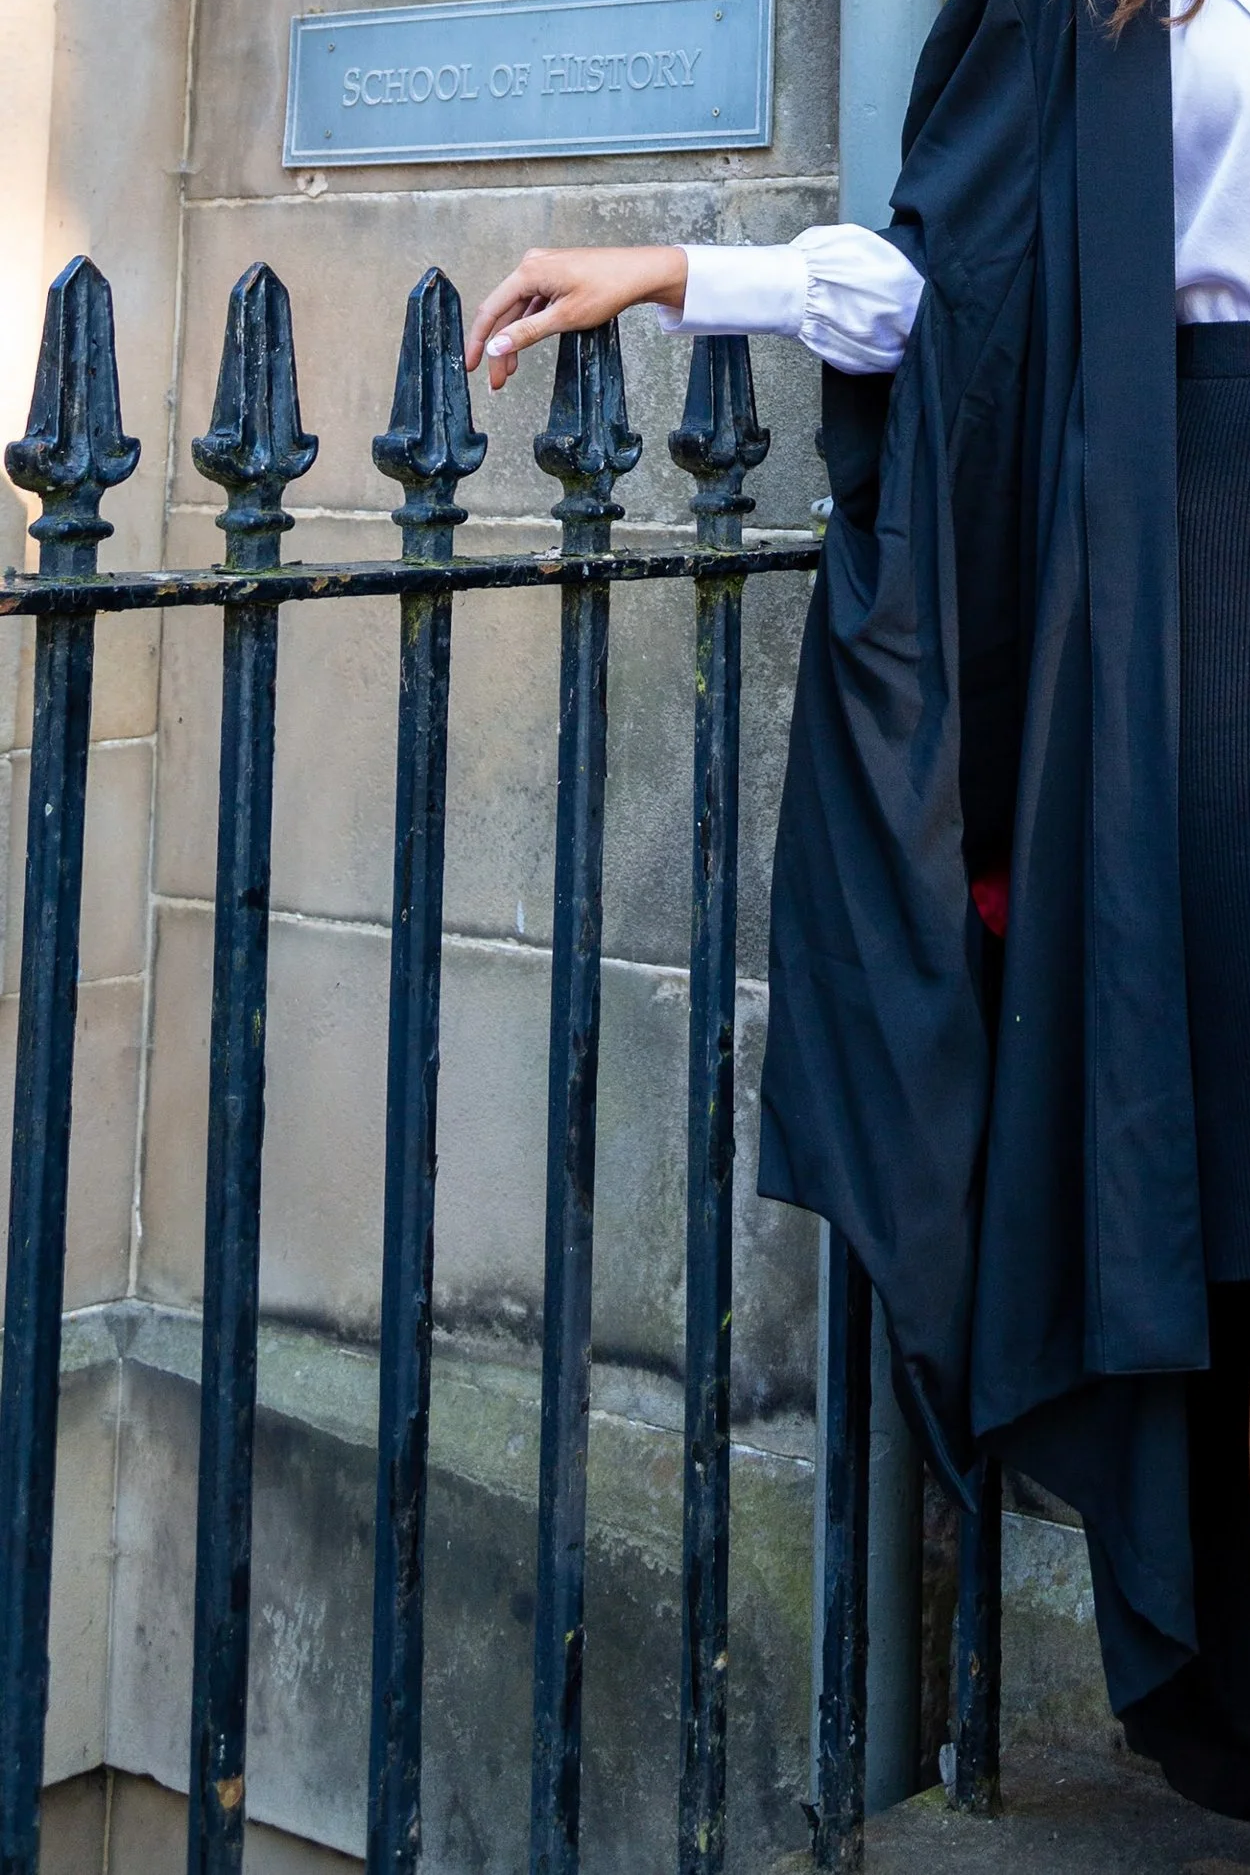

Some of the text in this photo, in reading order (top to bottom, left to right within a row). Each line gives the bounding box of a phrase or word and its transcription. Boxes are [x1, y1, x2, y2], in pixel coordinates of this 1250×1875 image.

[342, 48, 702, 107] SCHOOL OF HISTORY
